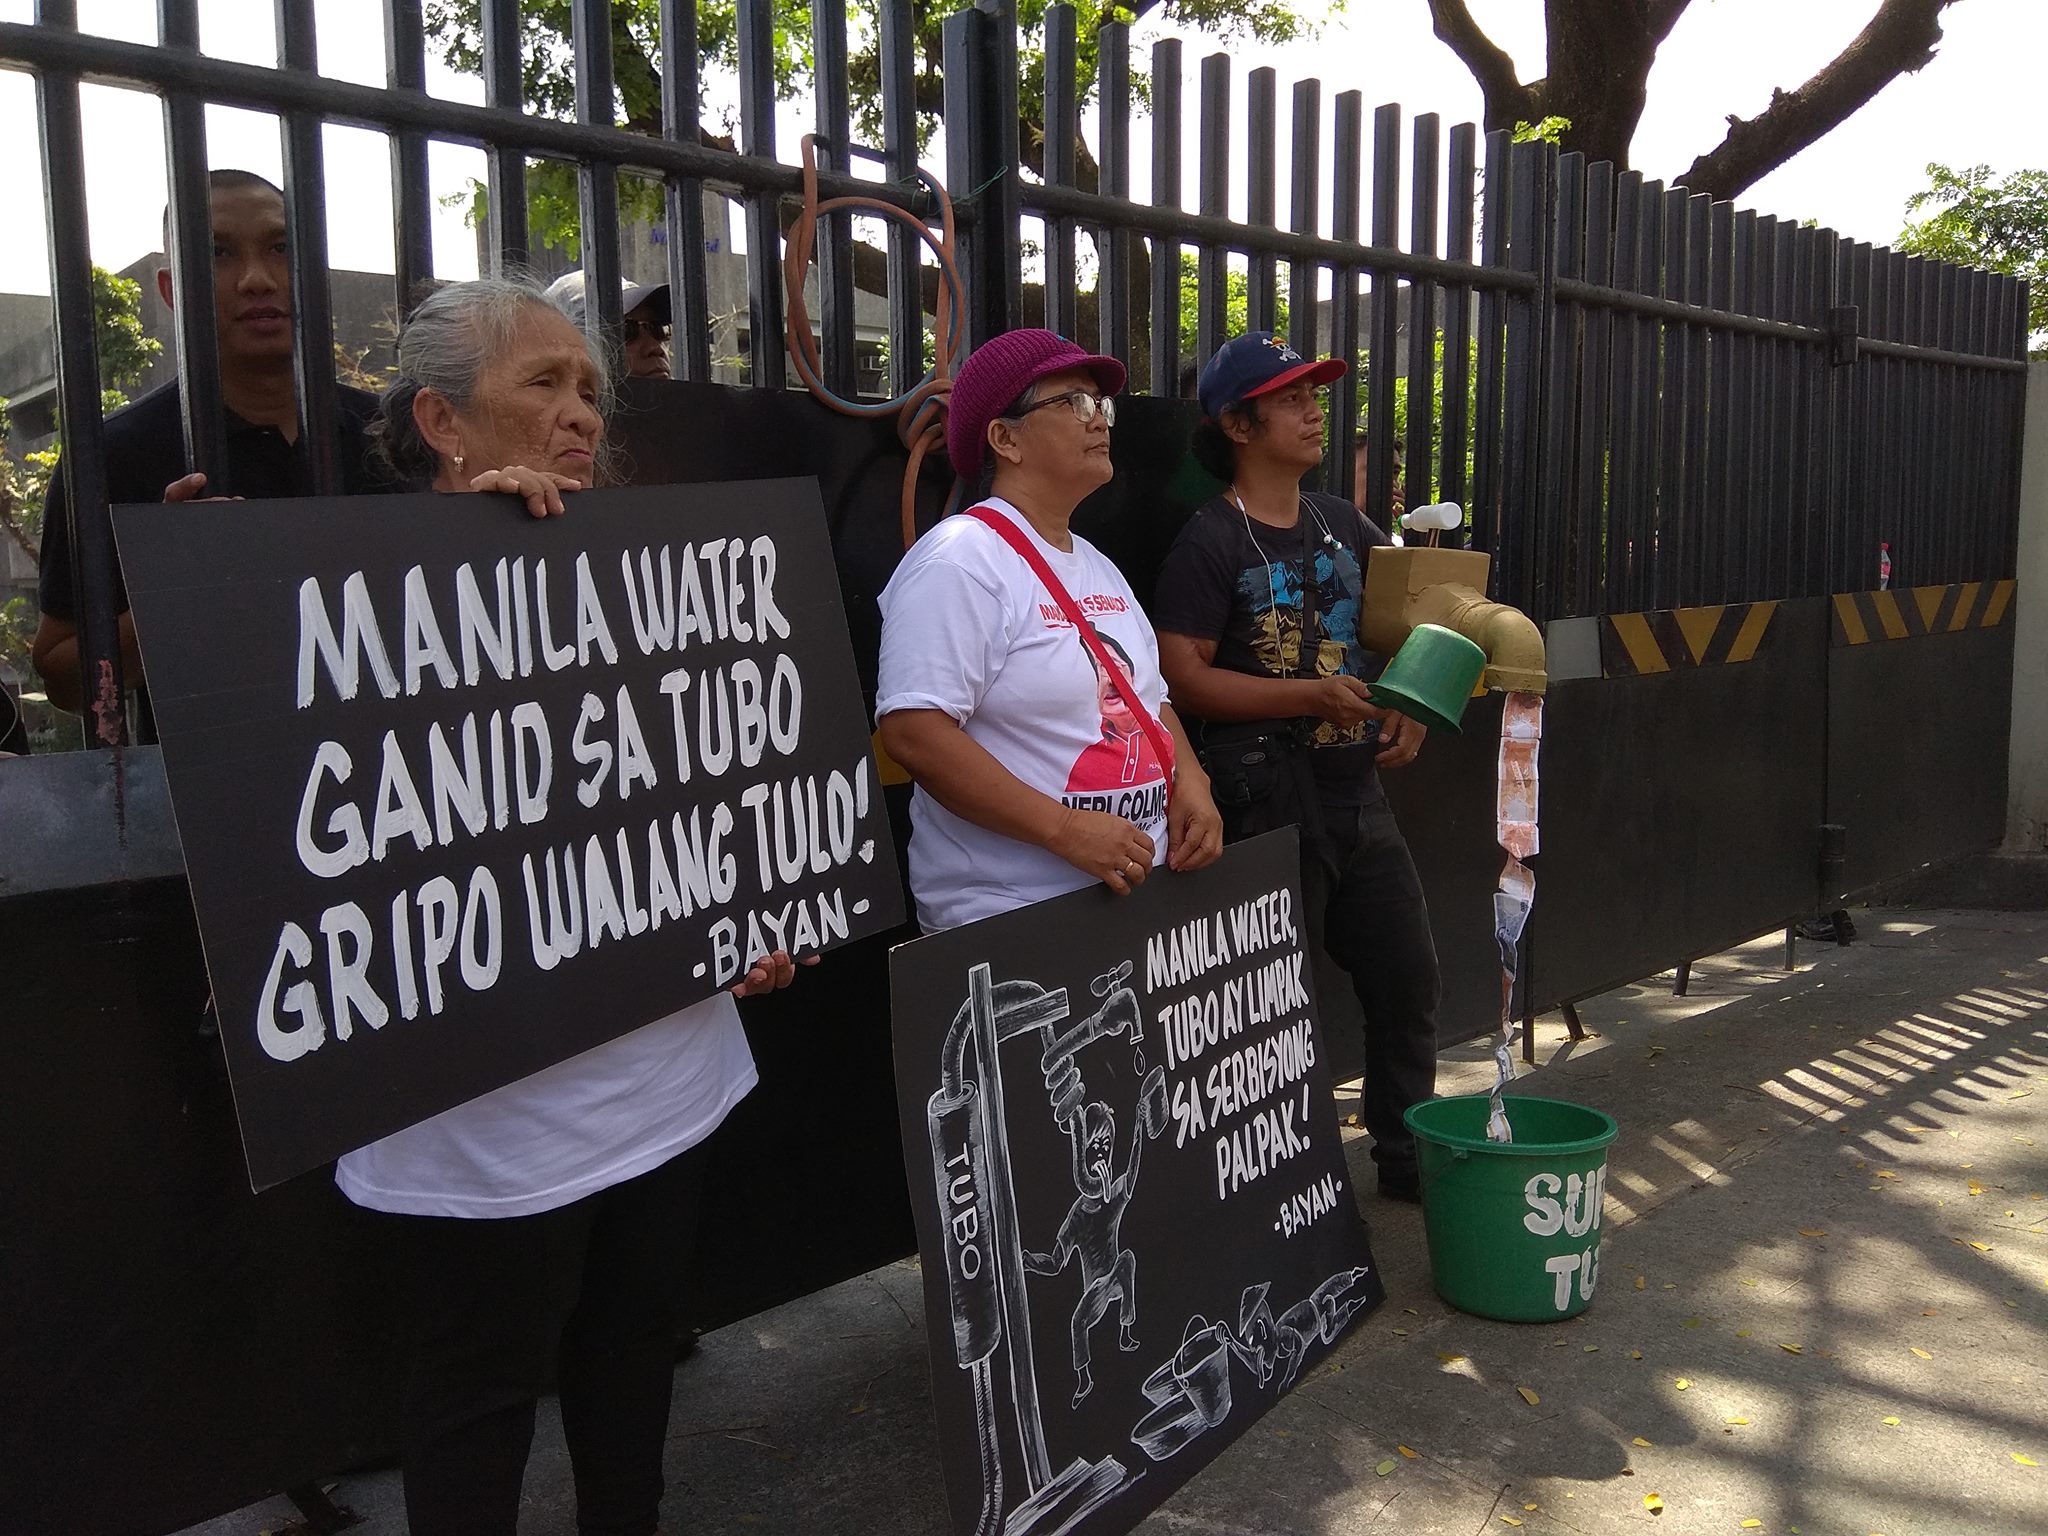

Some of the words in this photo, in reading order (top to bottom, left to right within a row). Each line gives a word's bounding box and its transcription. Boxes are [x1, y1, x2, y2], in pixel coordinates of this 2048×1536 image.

[297, 551, 618, 710] MANILA
[620, 534, 791, 656] WATER
[295, 701, 553, 878] GANID
[571, 684, 658, 809] SA
[659, 653, 803, 783] TUBO
[256, 865, 504, 1062] GRIPO
[522, 801, 737, 972] WALANG
[740, 755, 876, 894] TULO!
[1146, 910, 1232, 995] MANILA
[1229, 887, 1298, 958] WATER,
[1157, 989, 1220, 1071] TUBO
[1222, 976, 1244, 1040] AY
[1246, 950, 1310, 1026] LIMPAK
[1172, 1076, 1206, 1150] SA
[1205, 1018, 1316, 1129] SERBISYONG
[1215, 1082, 1311, 1201] PALPAK!
[946, 1141, 982, 1281] TUBO
